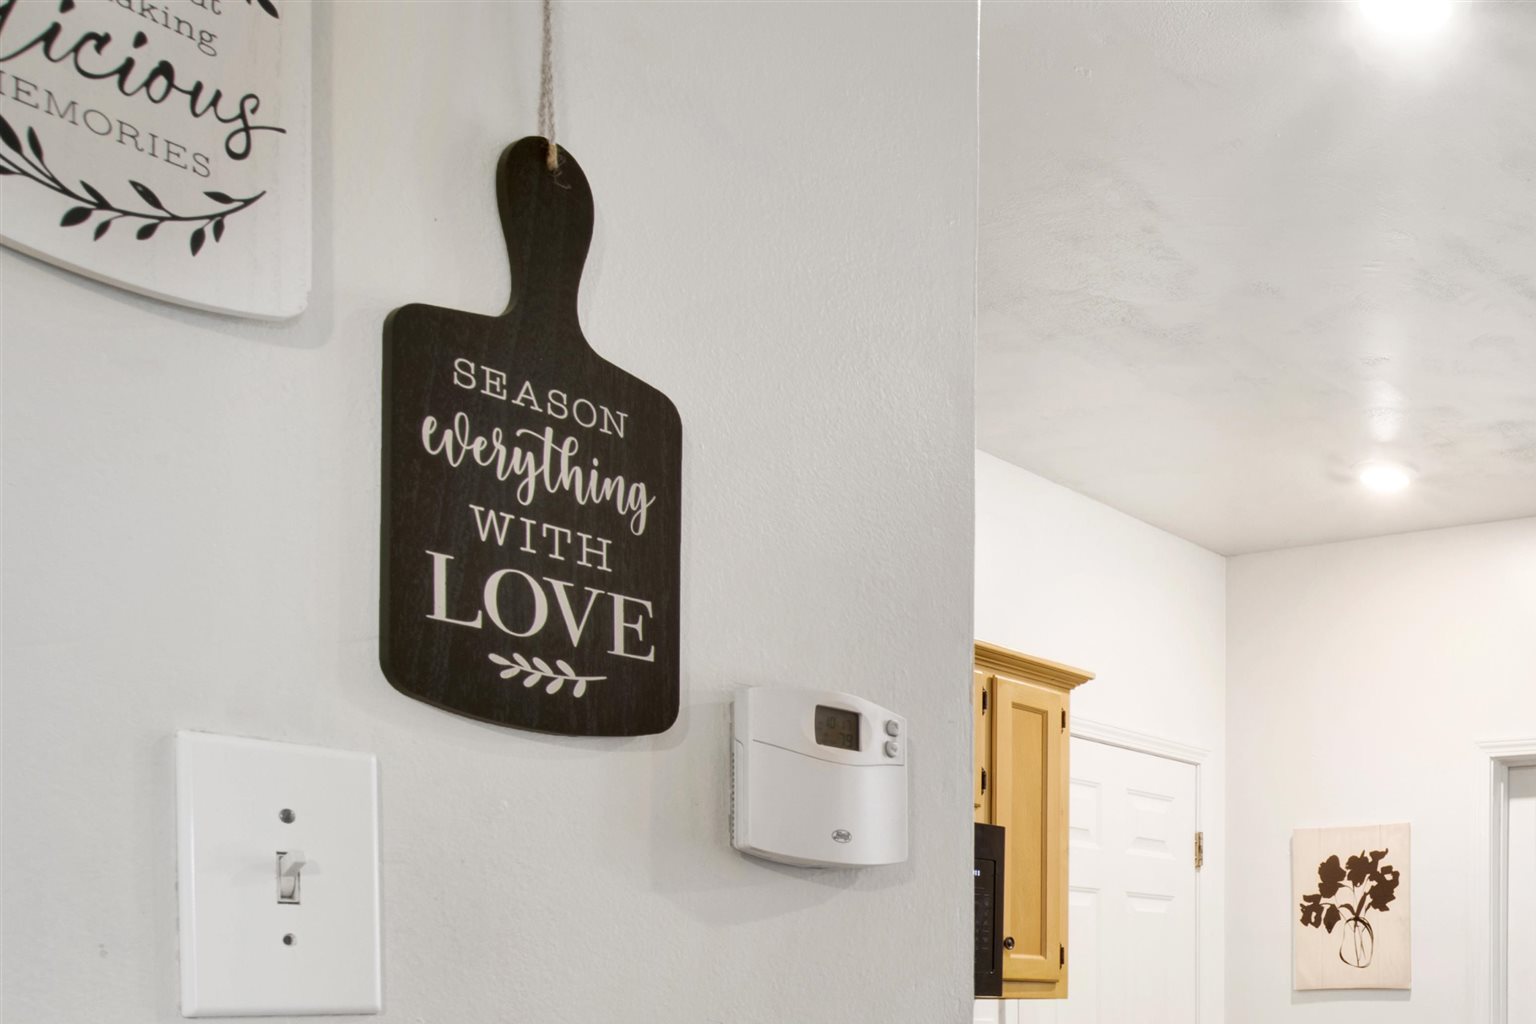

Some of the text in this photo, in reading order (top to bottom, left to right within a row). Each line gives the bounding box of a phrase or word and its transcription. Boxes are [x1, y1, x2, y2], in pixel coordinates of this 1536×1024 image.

[0, 70, 211, 178] EMORIES
[453, 357, 628, 439] SEASON
[421, 411, 657, 536] everything
[468, 503, 613, 572] WITH
[424, 549, 656, 662] LOVE
